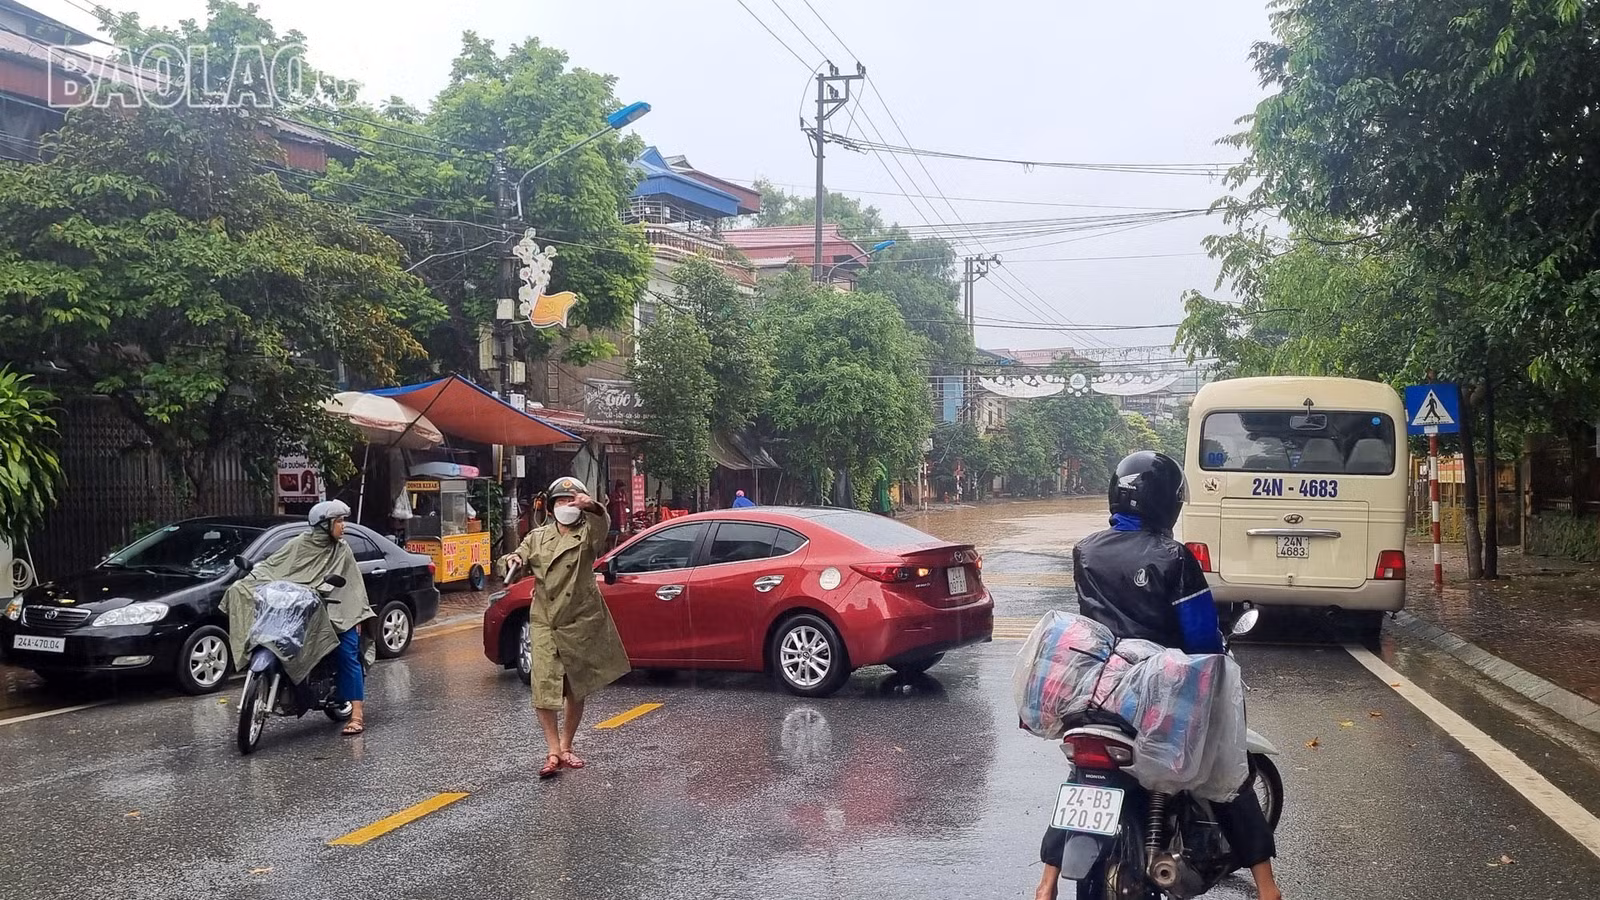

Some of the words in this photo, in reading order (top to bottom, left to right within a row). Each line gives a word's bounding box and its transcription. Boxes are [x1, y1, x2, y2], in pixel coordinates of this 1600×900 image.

[1252, 478, 1283, 497] 24N
[1298, 479, 1339, 498] 4683
[1283, 537, 1303, 547] 24N
[1280, 546, 1306, 557] 4683
[18, 637, 60, 649] 24A-470.04
[1066, 787, 1112, 809] 24-B3
[1060, 808, 1114, 831] 120.97
